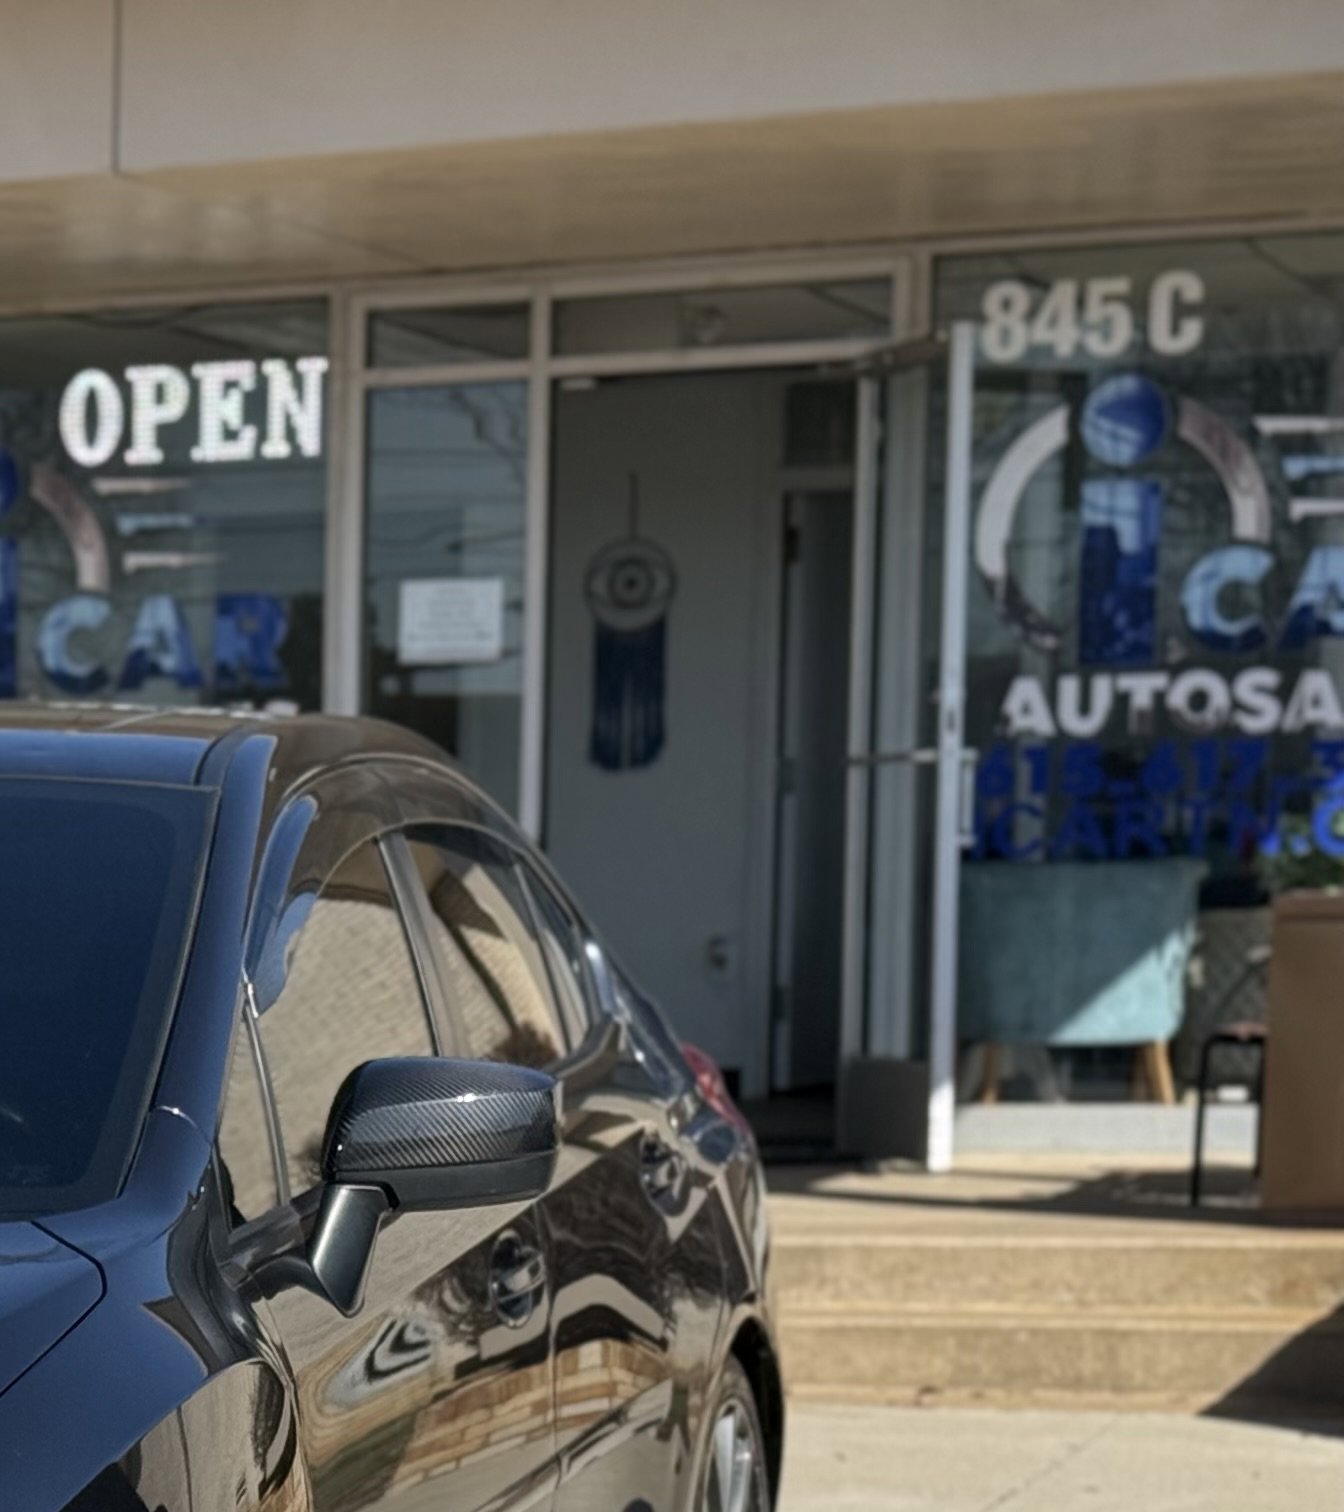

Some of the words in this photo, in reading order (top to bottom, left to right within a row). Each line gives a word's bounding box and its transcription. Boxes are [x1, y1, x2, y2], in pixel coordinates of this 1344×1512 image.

[979, 276, 1134, 364] 845
[1146, 270, 1205, 356] C
[58, 357, 330, 468] OPEN
